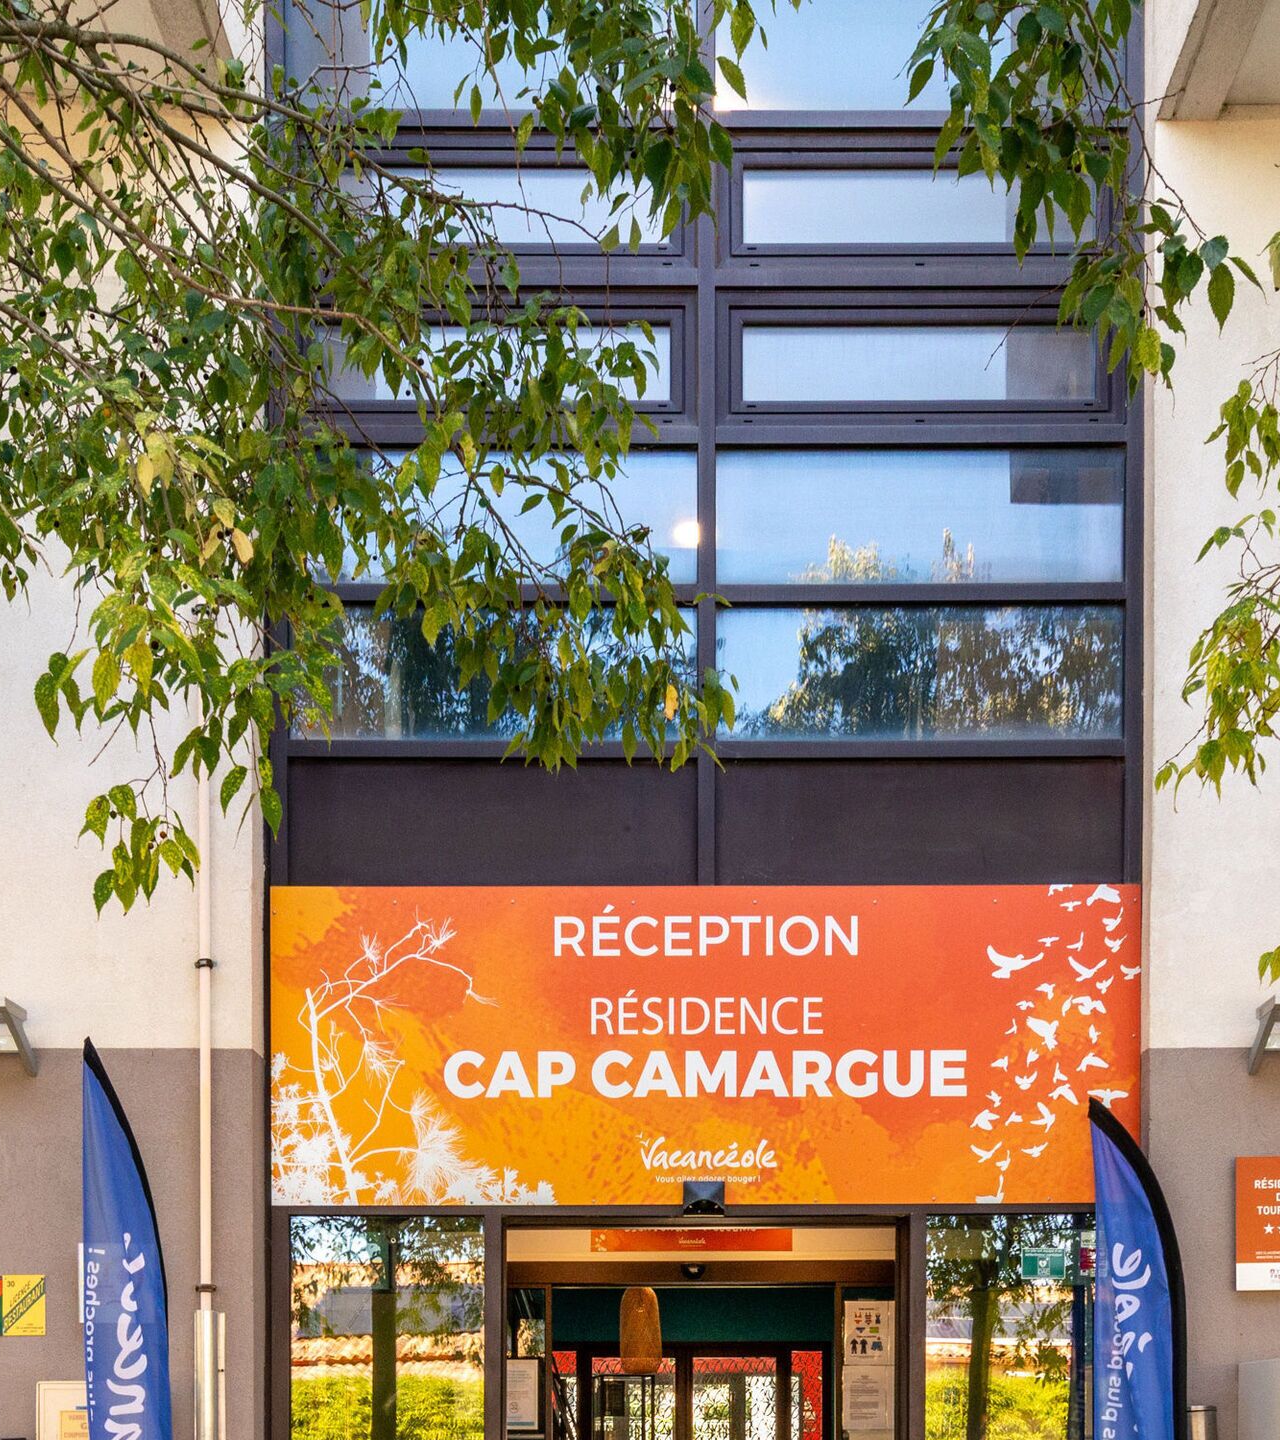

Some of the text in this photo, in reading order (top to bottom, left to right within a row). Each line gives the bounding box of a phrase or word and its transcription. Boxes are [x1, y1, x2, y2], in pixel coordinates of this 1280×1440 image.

[552, 904, 860, 958] RÉCEPTION
[589, 989, 824, 1036] RÉSIDENCE
[443, 1049, 968, 1100] CAP CAMARGUE
[640, 1136, 778, 1170] Vacancéole
[655, 1174, 674, 1184] Vous
[727, 1174, 756, 1184] bouger
[10, 1281, 31, 1308] LICENCE
